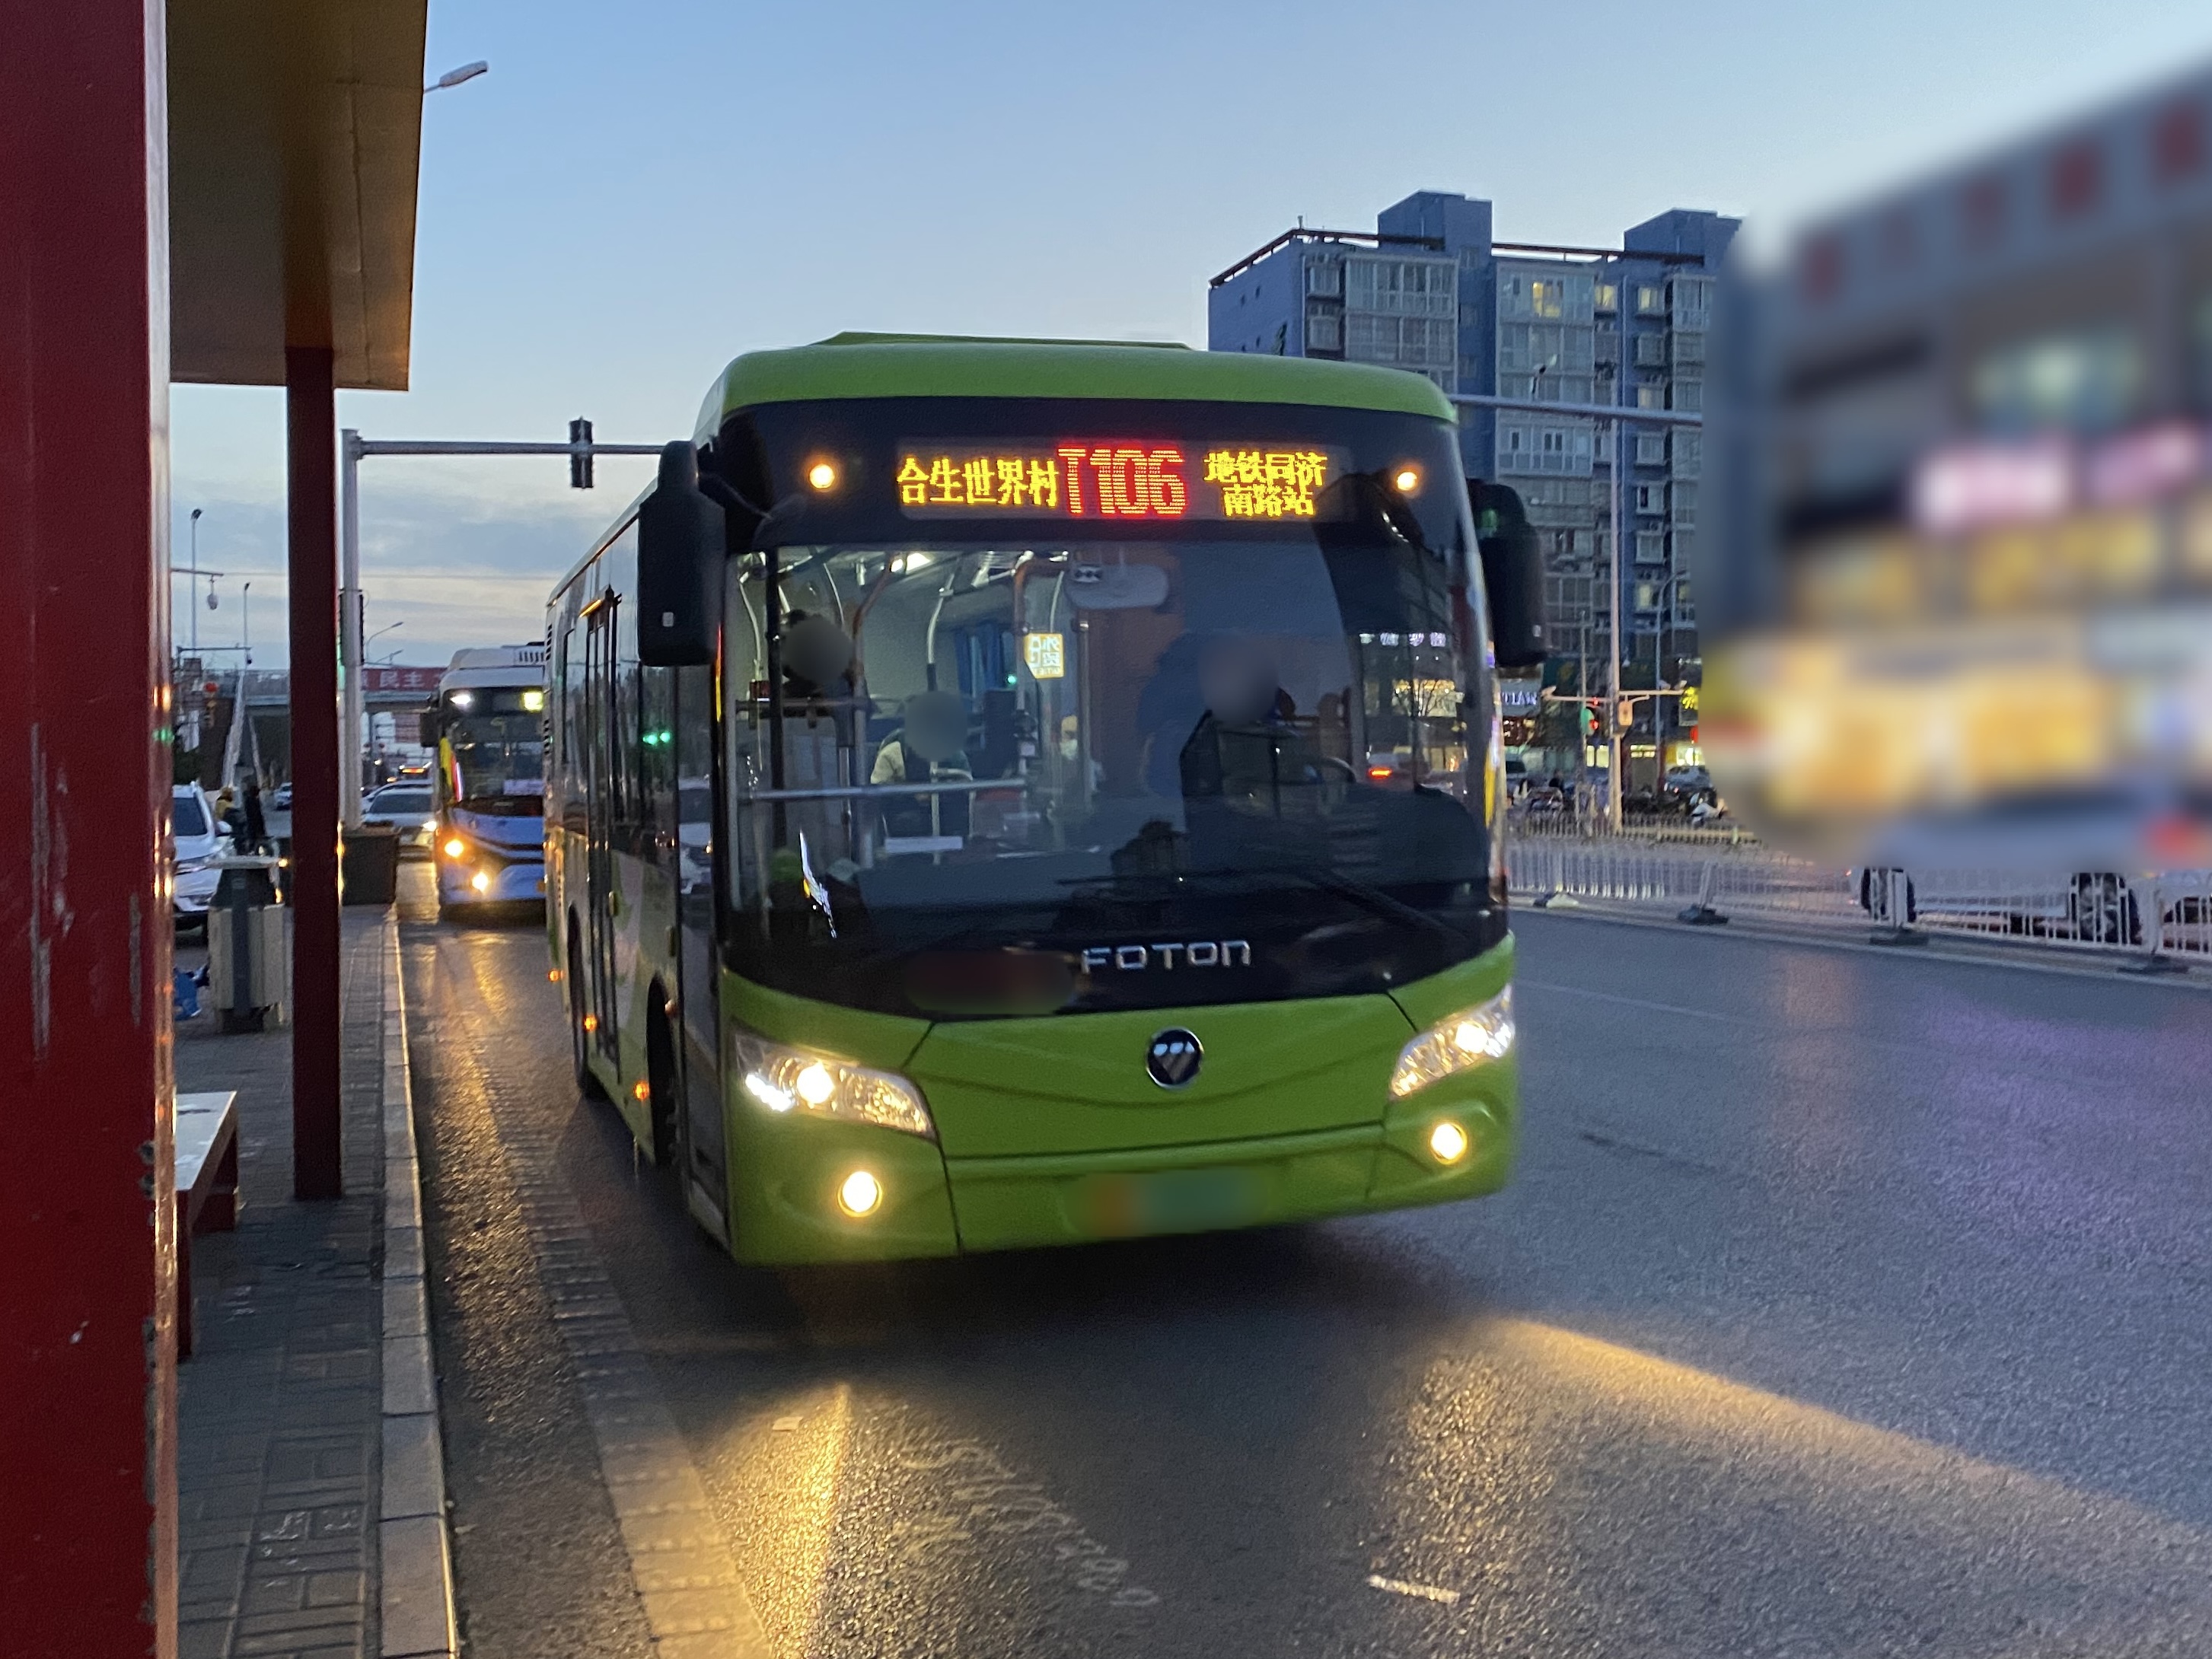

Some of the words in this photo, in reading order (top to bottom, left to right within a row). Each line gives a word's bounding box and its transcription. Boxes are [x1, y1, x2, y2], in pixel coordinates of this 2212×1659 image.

[897, 457, 1060, 507] 合生世界村
[1057, 448, 1187, 514] T106
[1203, 451, 1328, 487] 地铁同济
[1222, 484, 1315, 517] 南路站
[1081, 941, 1251, 974] FOTON
